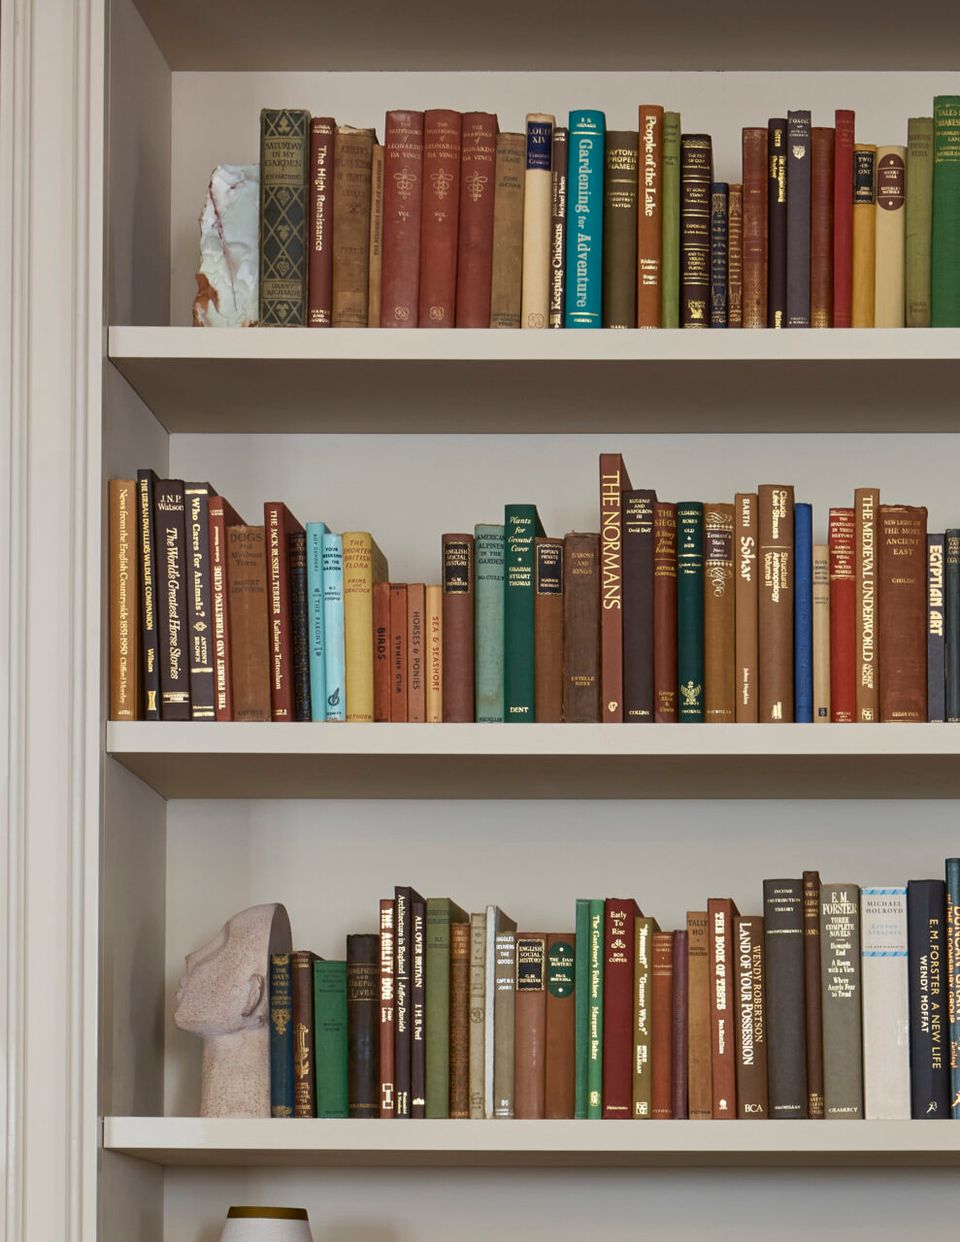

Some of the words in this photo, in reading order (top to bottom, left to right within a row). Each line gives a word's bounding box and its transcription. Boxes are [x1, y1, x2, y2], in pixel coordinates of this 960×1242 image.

[644, 115, 656, 152] People
[316, 146, 327, 164] The
[645, 154, 655, 166] of
[314, 168, 326, 191] High
[576, 139, 593, 212] Gardening
[645, 167, 655, 186] the
[645, 188, 655, 216] Lake
[315, 195, 325, 251] Renaissance
[578, 216, 587, 229] for
[577, 233, 591, 307] Adventure
[120, 489, 128, 510] News
[602, 470, 620, 506] THE
[191, 498, 200, 520] Who
[742, 499, 750, 527] BARTH
[779, 490, 787, 518] Claude
[862, 496, 873, 520] THE
[119, 511, 128, 528] from
[120, 529, 128, 542] the
[167, 528, 178, 545] The
[192, 523, 202, 550] Cares
[863, 522, 873, 578] MEDIEVAL
[119, 543, 128, 572] English
[167, 546, 180, 579] World's
[192, 553, 202, 567] for
[602, 511, 620, 609] NORMANS
[740, 536, 755, 581] Sohar
[764, 552, 772, 581] Volume
[780, 552, 788, 589] Structural
[771, 552, 781, 603] Anthropology
[930, 545, 942, 606] EGYPTIAN
[119, 573, 128, 619] Countryside
[167, 580, 179, 618] Greatest
[193, 571, 205, 617] Animals?
[169, 619, 180, 646] Horse
[412, 611, 421, 645] HORSES
[432, 616, 440, 634] SEA
[863, 580, 873, 662] UNDERWORLD
[930, 611, 943, 636] ART
[120, 621, 128, 655] 1851-1950
[377, 627, 385, 660] BIRDS
[169, 647, 181, 679] Stories
[432, 646, 440, 692] SEASHORE
[382, 908, 392, 929] THE
[715, 912, 724, 934] THE
[929, 919, 939, 928] E.
[715, 936, 724, 962] BOOK
[739, 923, 751, 953] LAND
[930, 931, 939, 942] M.
[382, 932, 393, 974] AGILITY
[740, 955, 751, 970] OF
[752, 945, 761, 981] WENDY
[716, 964, 724, 977] OF
[920, 956, 928, 991] WENDY
[930, 944, 940, 995] FORSTER
[382, 978, 393, 1000] DOG
[716, 978, 726, 1010] TESTS
[740, 971, 752, 1001] YOUR
[753, 984, 762, 1042] ROBERTSON
[920, 995, 929, 1033] MOFFAT
[931, 1002, 940, 1010] A
[741, 1003, 753, 1065] POSSESSION
[931, 1014, 941, 1043] NEW
[932, 1047, 941, 1069] LIFE
